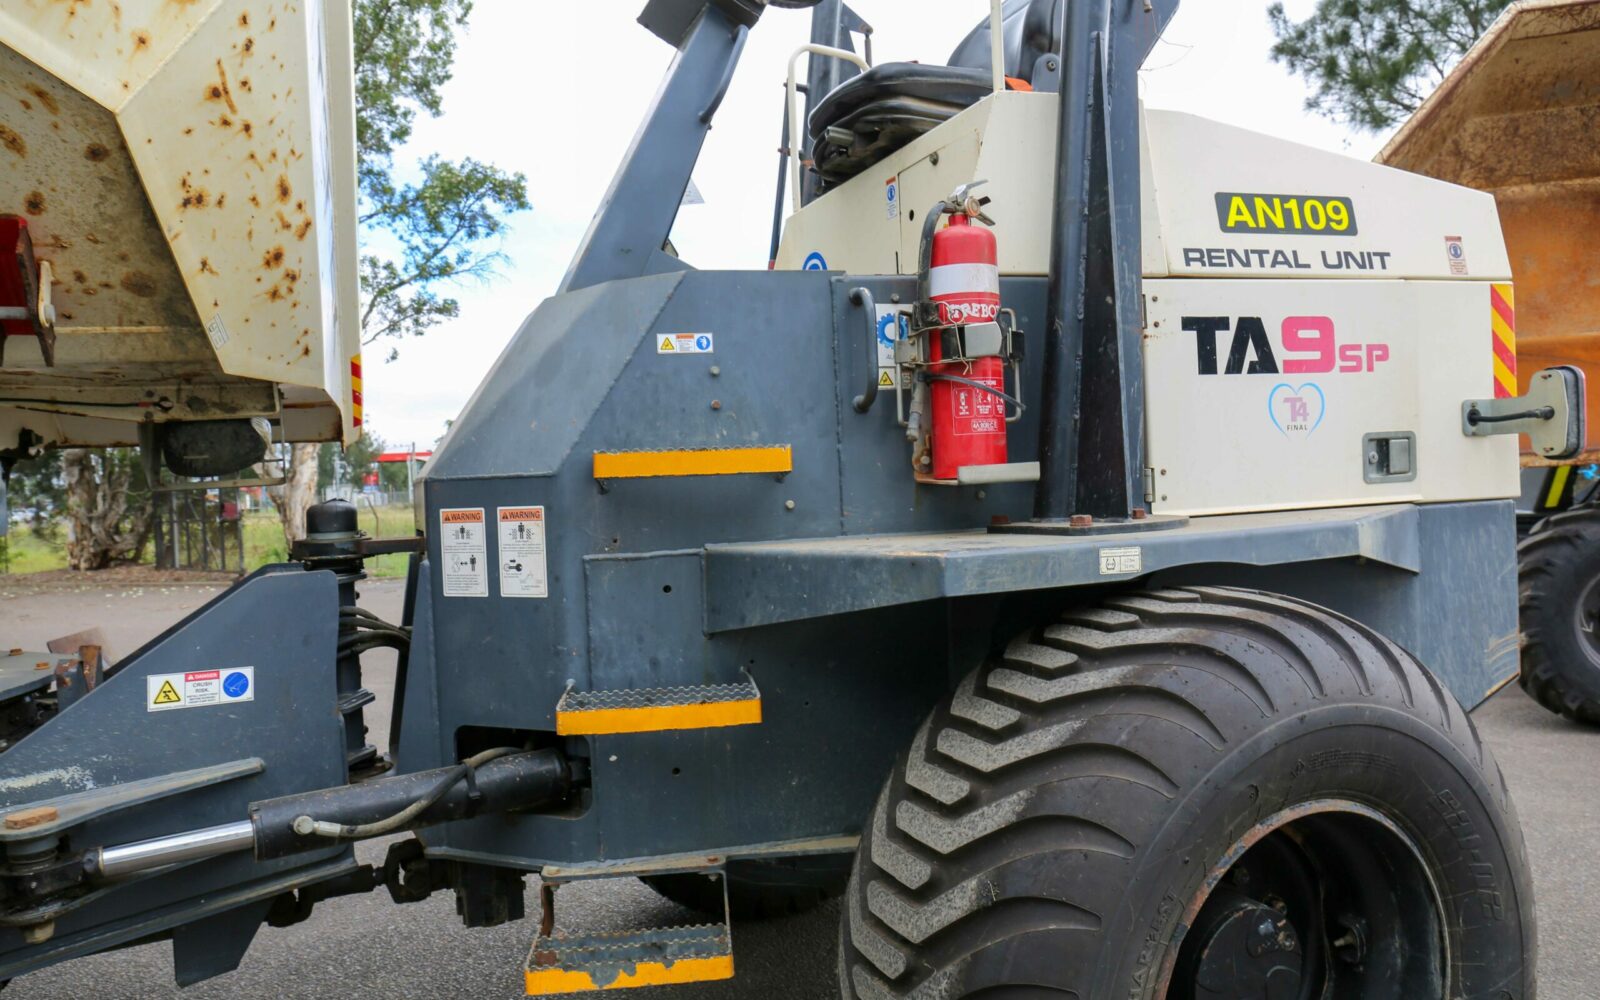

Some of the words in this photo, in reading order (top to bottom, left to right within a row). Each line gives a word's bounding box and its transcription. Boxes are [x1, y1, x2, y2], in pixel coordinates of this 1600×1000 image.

[1226, 196, 1349, 231] AN109
[1182, 247, 1311, 269] RENTAL
[1320, 250, 1391, 270] UNIT
[1283, 397, 1310, 422] T4
[451, 512, 481, 521] WARNING
[509, 511, 541, 520] WARNING
